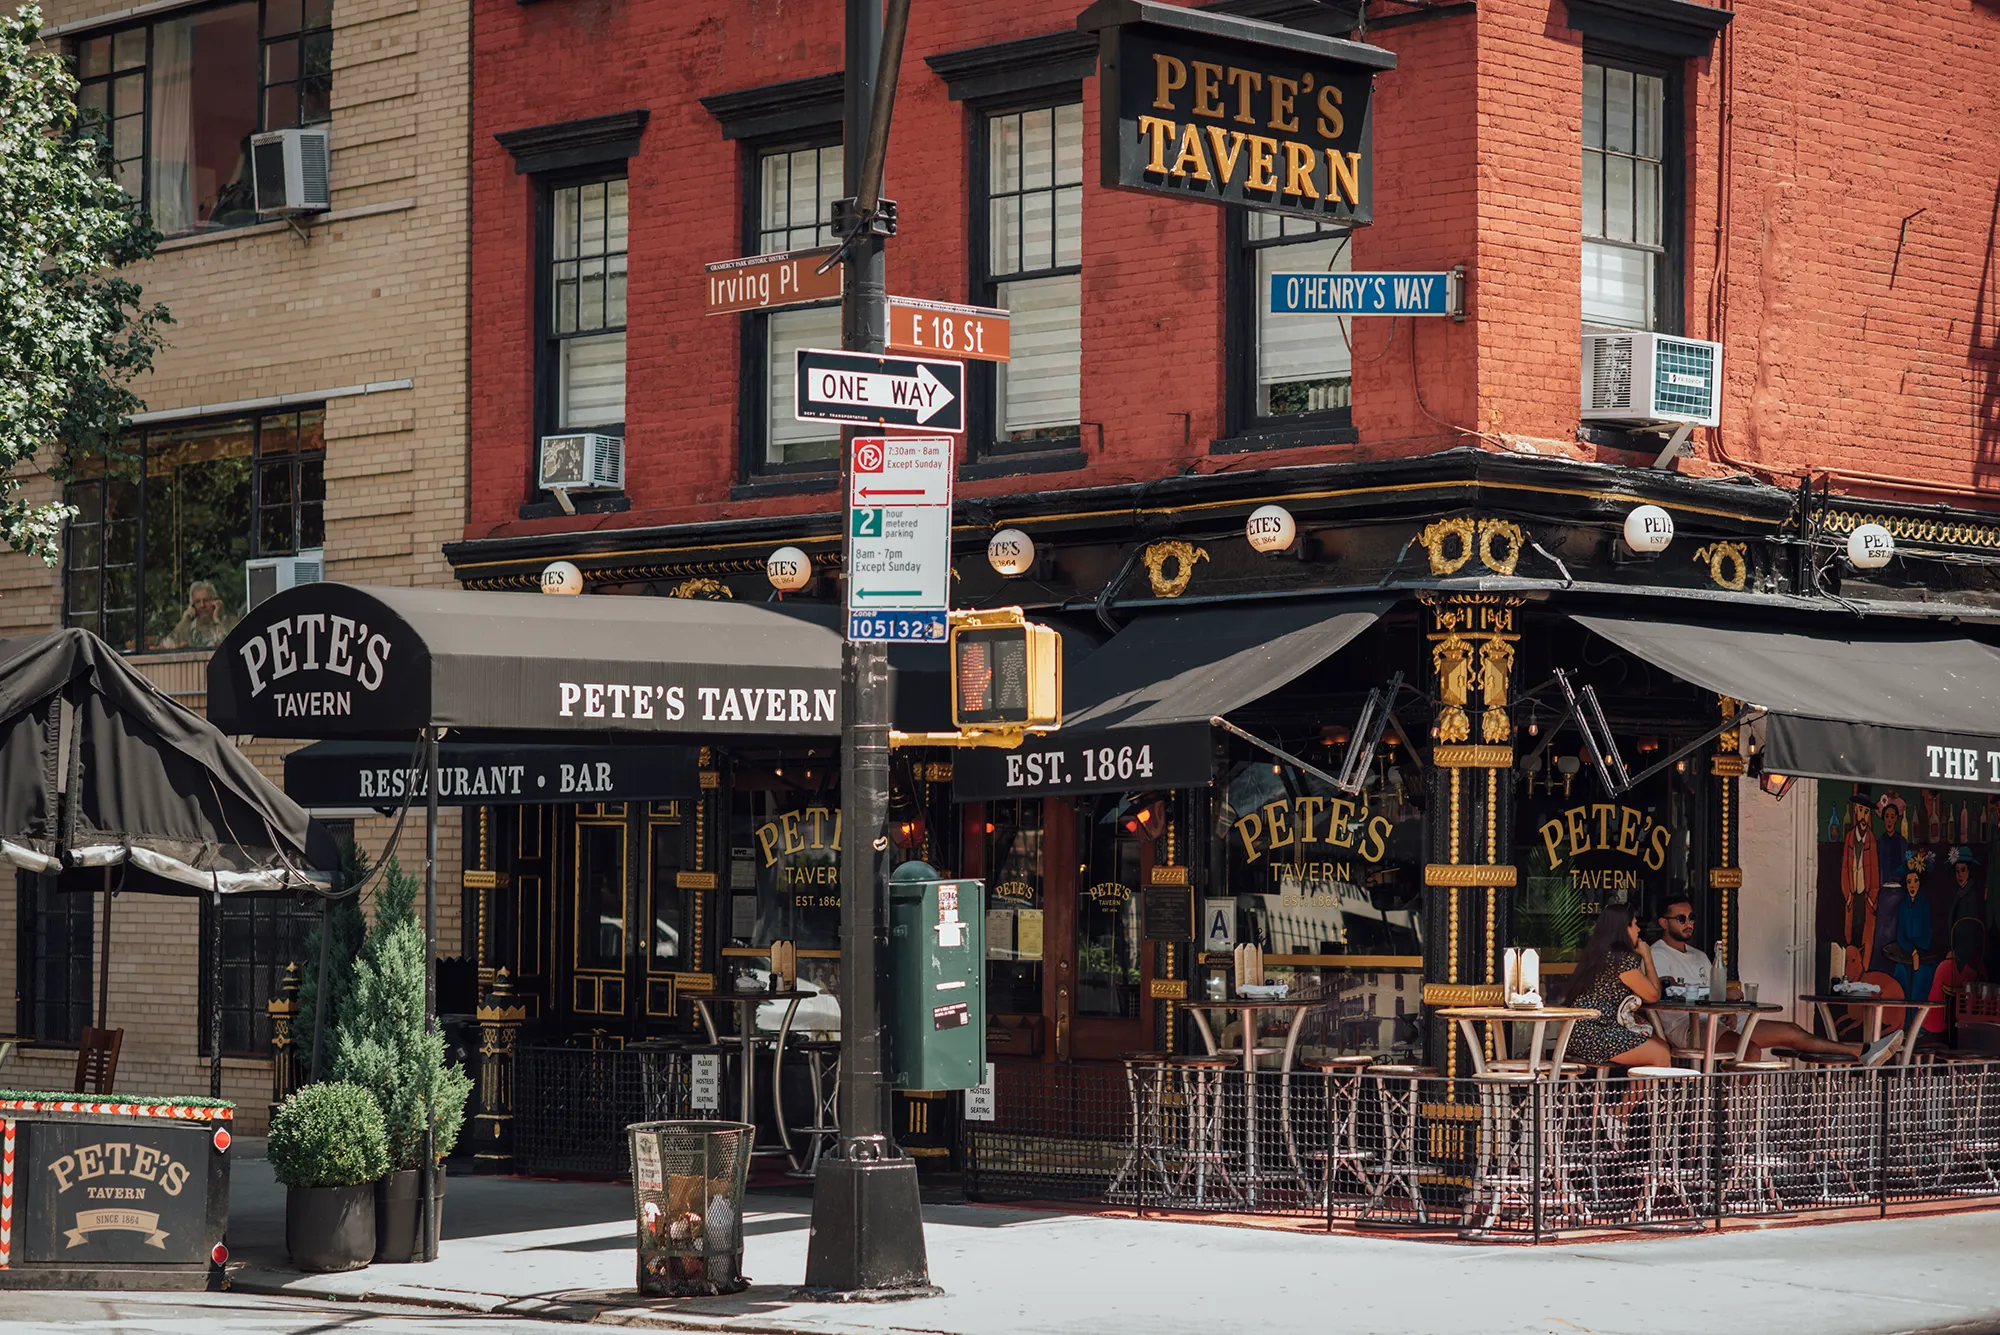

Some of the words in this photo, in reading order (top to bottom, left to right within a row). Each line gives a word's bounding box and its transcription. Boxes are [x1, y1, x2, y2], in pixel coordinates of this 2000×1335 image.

[1152, 53, 1345, 139] PETE'S
[1138, 114, 1362, 205] TAVERN
[710, 262, 736, 271] GRAMERCY
[748, 257, 768, 265] HISTORIC
[768, 253, 789, 262] DISTRICT
[711, 269, 770, 306] Irving
[780, 261, 799, 295] Pl
[1287, 277, 1385, 310] O'HENRY'S
[1393, 277, 1434, 310] WAY
[913, 314, 923, 346] E
[932, 316, 954, 350] 18
[964, 320, 984, 353] St
[822, 373, 869, 401] ONE
[891, 380, 938, 407] WAY
[829, 413, 868, 421] TRANSPORTATION
[888, 446, 916, 456] 7:30am
[922, 446, 940, 456] 8am
[887, 460, 913, 469] Except
[915, 460, 943, 469] Sunday
[859, 508, 875, 535] 2
[885, 510, 903, 518] hour
[885, 519, 918, 528] metered
[885, 529, 914, 539] parking
[1247, 516, 1281, 535] ETE'S
[1644, 517, 1673, 534] PETE
[855, 549, 875, 559] 8am
[884, 549, 903, 560] 7pm
[989, 540, 1020, 557] ETE'S
[769, 560, 797, 577] ETE'S
[855, 562, 886, 573] Except
[888, 561, 921, 573] Sunday
[852, 619, 923, 638] 105132
[239, 613, 392, 698] PETE'S
[273, 691, 351, 718] TAVERN
[559, 682, 685, 721] PETE'S
[698, 687, 837, 722] TAVERN
[1006, 751, 1072, 787] EST.
[1082, 744, 1154, 782] 1864
[1926, 745, 1979, 781] THE
[559, 762, 614, 793] BAR
[1234, 796, 1394, 865] PETE'S
[1538, 803, 1672, 871] PETE'S
[784, 866, 838, 884] TAVER
[1270, 862, 1350, 882] TAVERN
[1570, 870, 1637, 889] TAVERN
[995, 881, 1034, 899] PETE'S
[1089, 882, 1132, 901] PETE'S
[795, 896, 816, 907] EST.
[1311, 895, 1340, 908] 1864
[1210, 909, 1229, 939] A
[969, 1087, 991, 1095] HOSTESS
[970, 1106, 990, 1114] SEATING
[48, 1142, 191, 1197] PETE'S
[87, 1187, 146, 1200] TAVERN
[96, 1214, 119, 1225] SINCE
[121, 1215, 140, 1225] 1864
